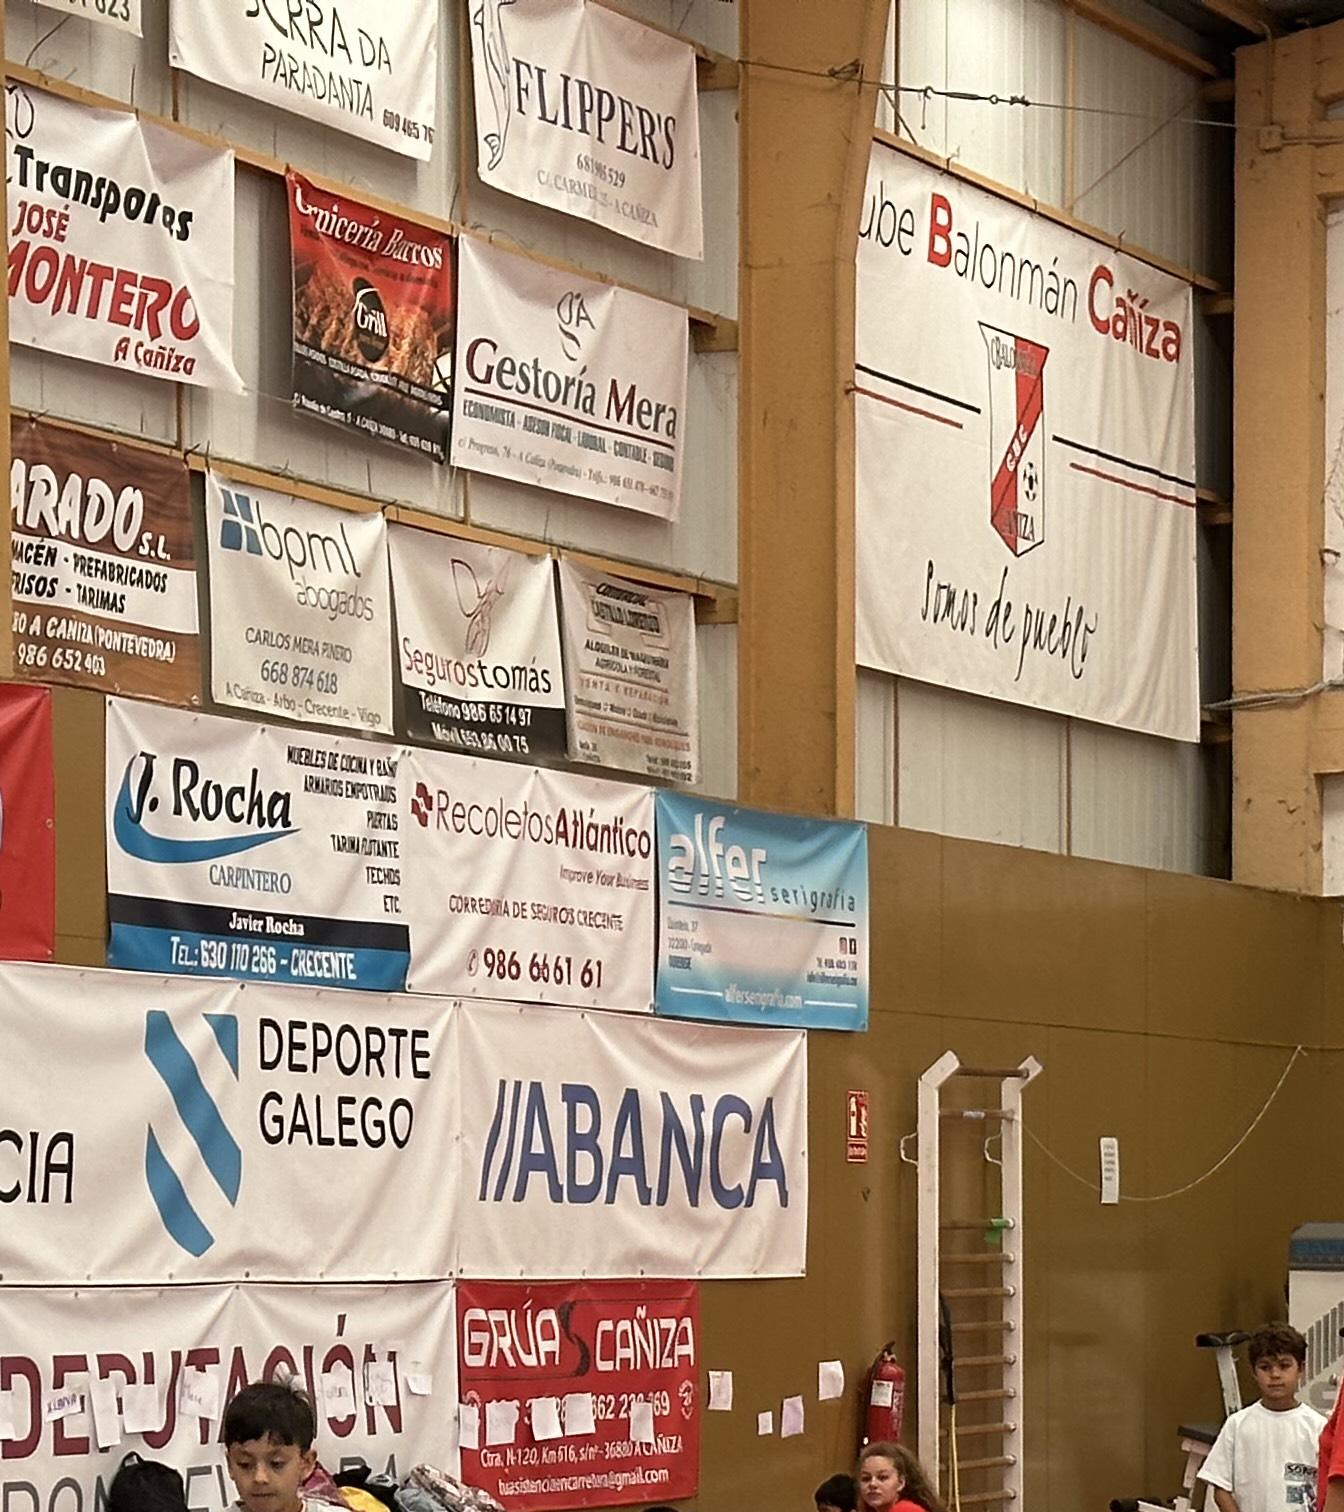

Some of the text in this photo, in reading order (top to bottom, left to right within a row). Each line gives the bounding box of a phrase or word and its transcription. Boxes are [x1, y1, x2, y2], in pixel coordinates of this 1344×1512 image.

[358, 28, 392, 74] DA
[261, 42, 374, 121] PARADANTA
[512, 57, 676, 170] FLIPPER'S
[12, 201, 70, 243] JOSÉ
[385, 227, 443, 270] Barros
[927, 191, 1079, 324] Balonmán
[355, 302, 388, 339] Grill
[134, 342, 196, 376] Cañiza
[465, 337, 596, 417] Gestoría
[605, 378, 677, 440] Mera
[138, 532, 171, 560] S.L.
[256, 500, 362, 578] bpml
[73, 552, 168, 593] PREFABRICADOS
[76, 584, 126, 614] TARIMAS
[296, 576, 374, 624] abogados
[94, 624, 177, 664] (PONTEVEDRA)
[245, 627, 291, 650] CARLOS
[1014, 594, 1099, 682] pueblo
[18, 642, 106, 676] 986 652 403
[260, 659, 338, 695] 668 874 618
[402, 637, 552, 694] Segurostomás
[305, 697, 350, 720] Crecente
[357, 706, 381, 726] Vigo
[418, 691, 487, 723] Teléfono 986
[126, 751, 292, 829] J. Rocha
[209, 864, 292, 894] CARPINTERO
[366, 866, 400, 886] TECHOS
[560, 866, 593, 886] Improve
[668, 813, 767, 905] alfer
[229, 912, 305, 937] Javier Rocha
[448, 894, 575, 927] CORREDURÍA SEGUROS
[200, 939, 357, 980] 630 110 266 CRECENTE
[483, 948, 603, 989] 986 61
[259, 1018, 432, 1080] DEPORTE
[259, 1090, 414, 1150] GALEGO
[595, 1305, 695, 1372] CAÑIZA
